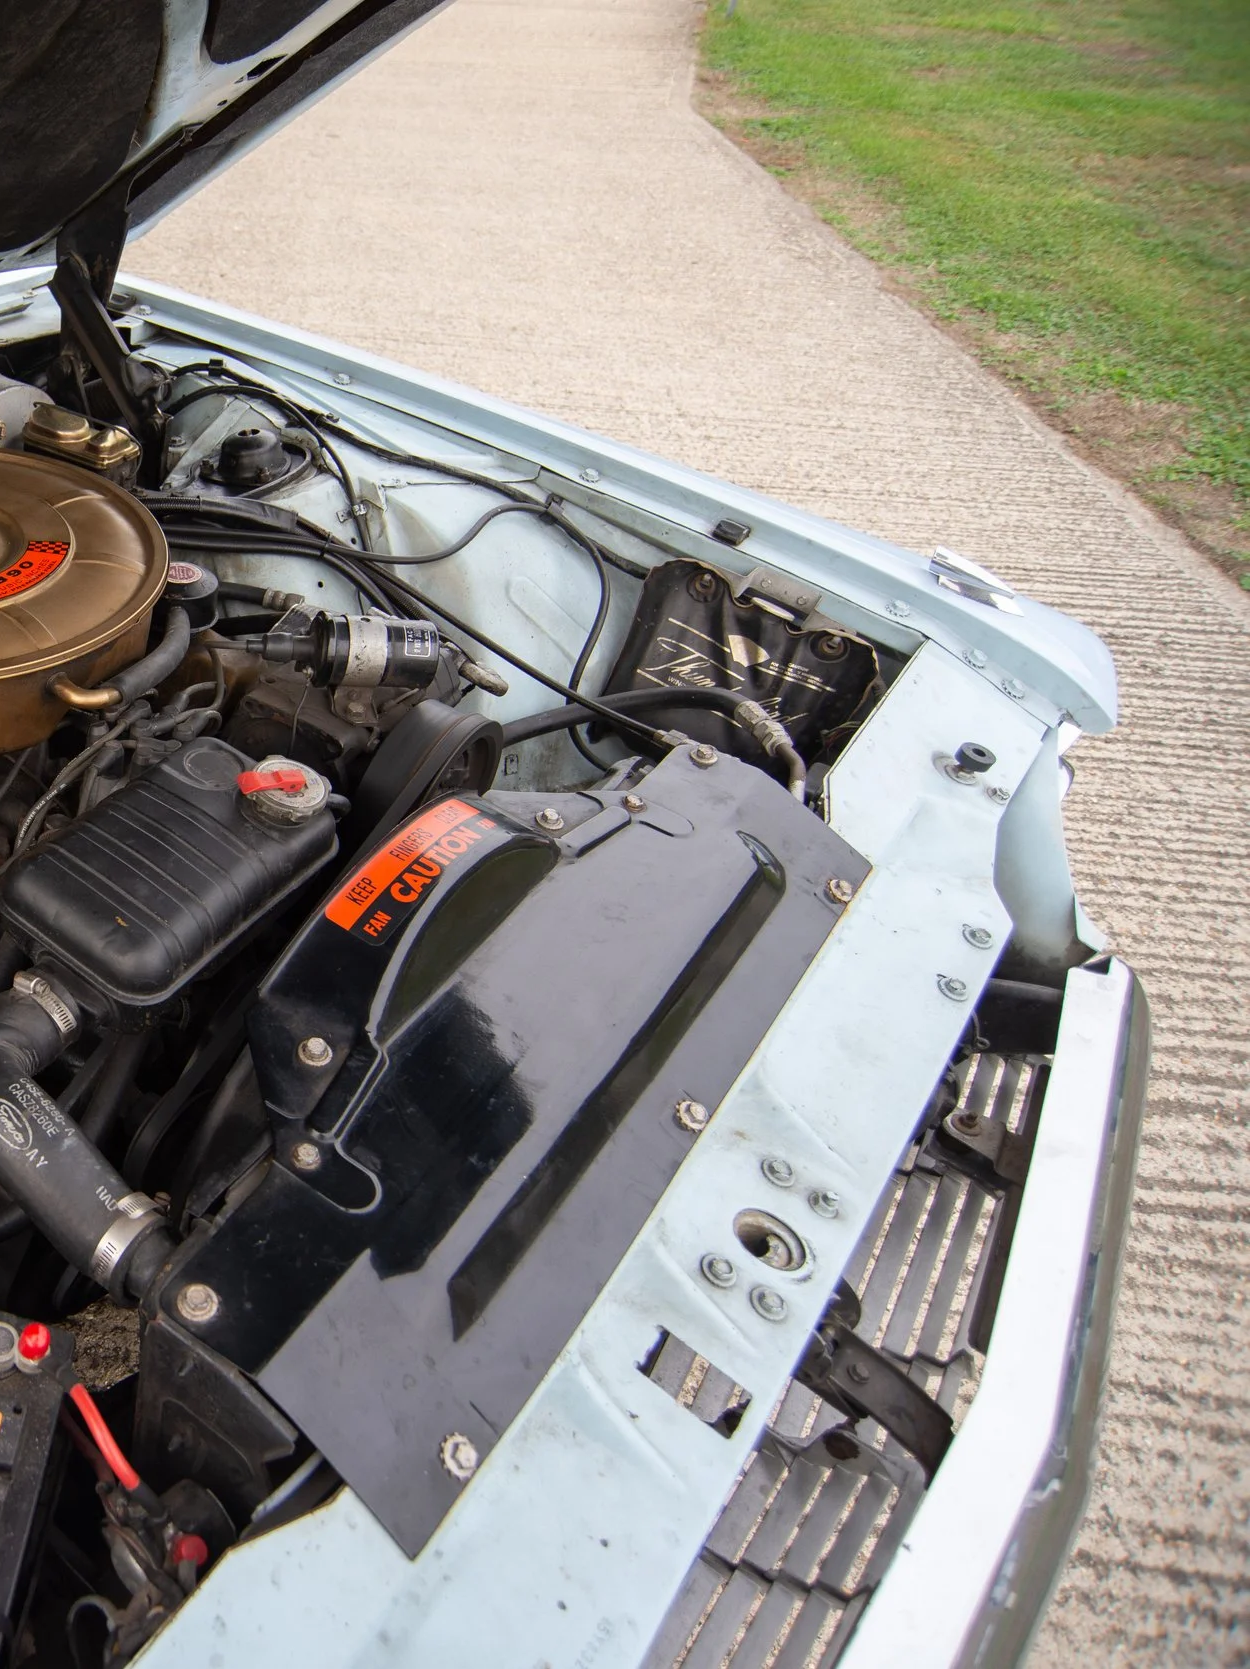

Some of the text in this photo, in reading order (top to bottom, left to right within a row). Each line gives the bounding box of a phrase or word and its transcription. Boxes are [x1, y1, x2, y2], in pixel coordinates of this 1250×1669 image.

[23, 559, 50, 579] INCHES
[346, 877, 377, 906] KEEP
[389, 827, 434, 862] FINGERS
[363, 910, 392, 937] FAN
[390, 825, 482, 903] CAUTION
